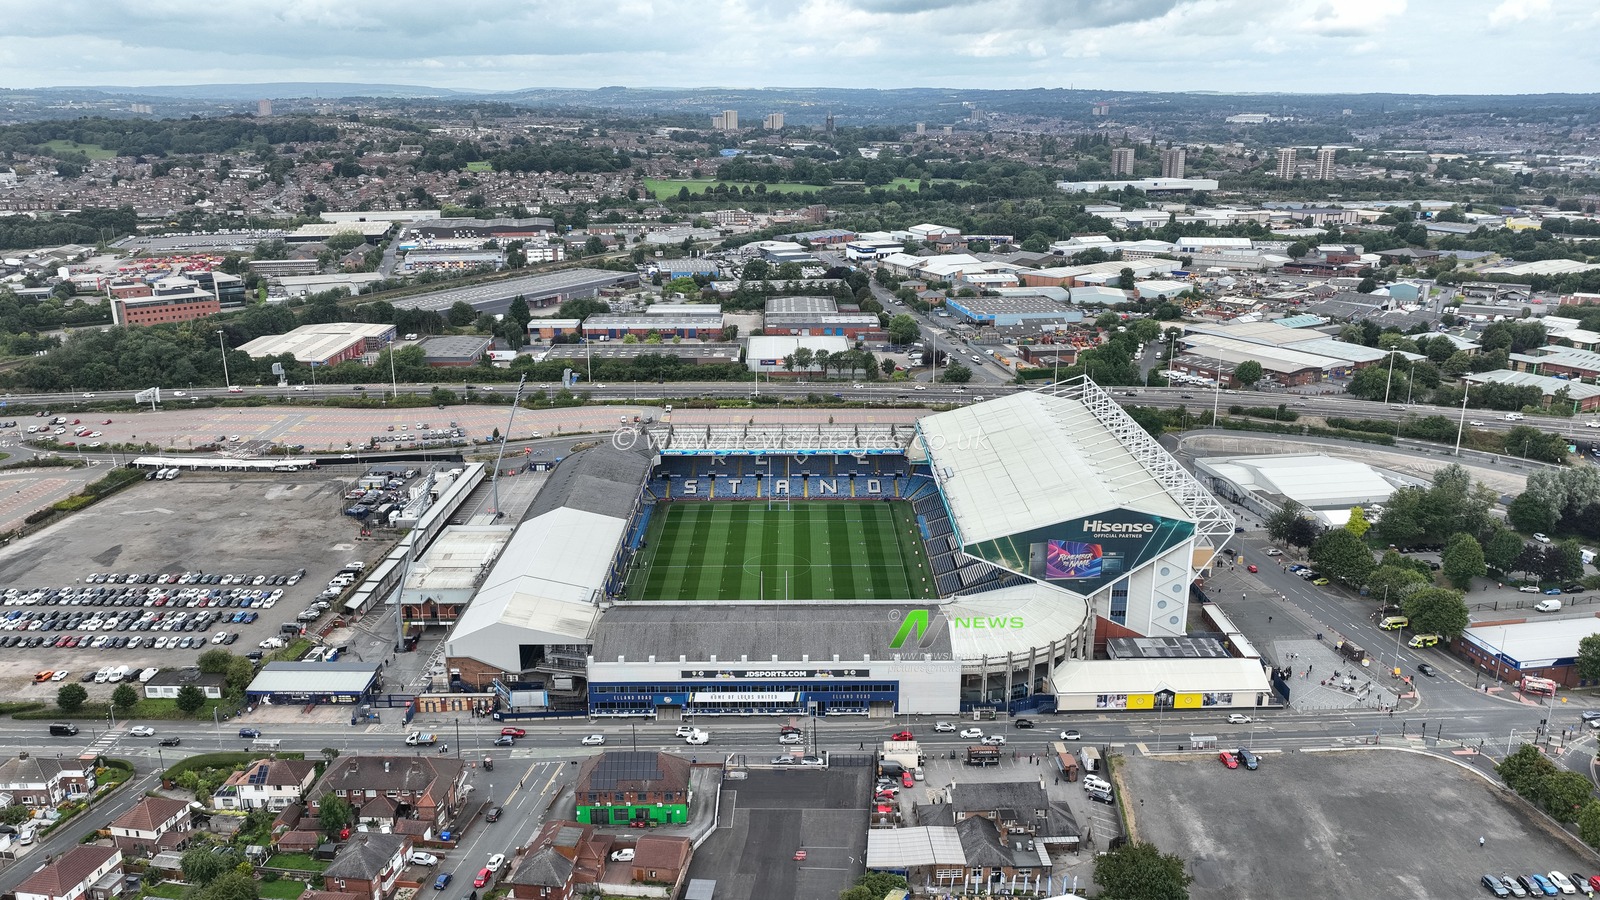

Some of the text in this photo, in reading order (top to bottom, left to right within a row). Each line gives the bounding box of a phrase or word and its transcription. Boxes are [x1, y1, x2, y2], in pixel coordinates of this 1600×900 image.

[684, 480, 882, 494] STAND
[1083, 520, 1153, 533] Hisense
[1058, 553, 1093, 561] REMEMBER
